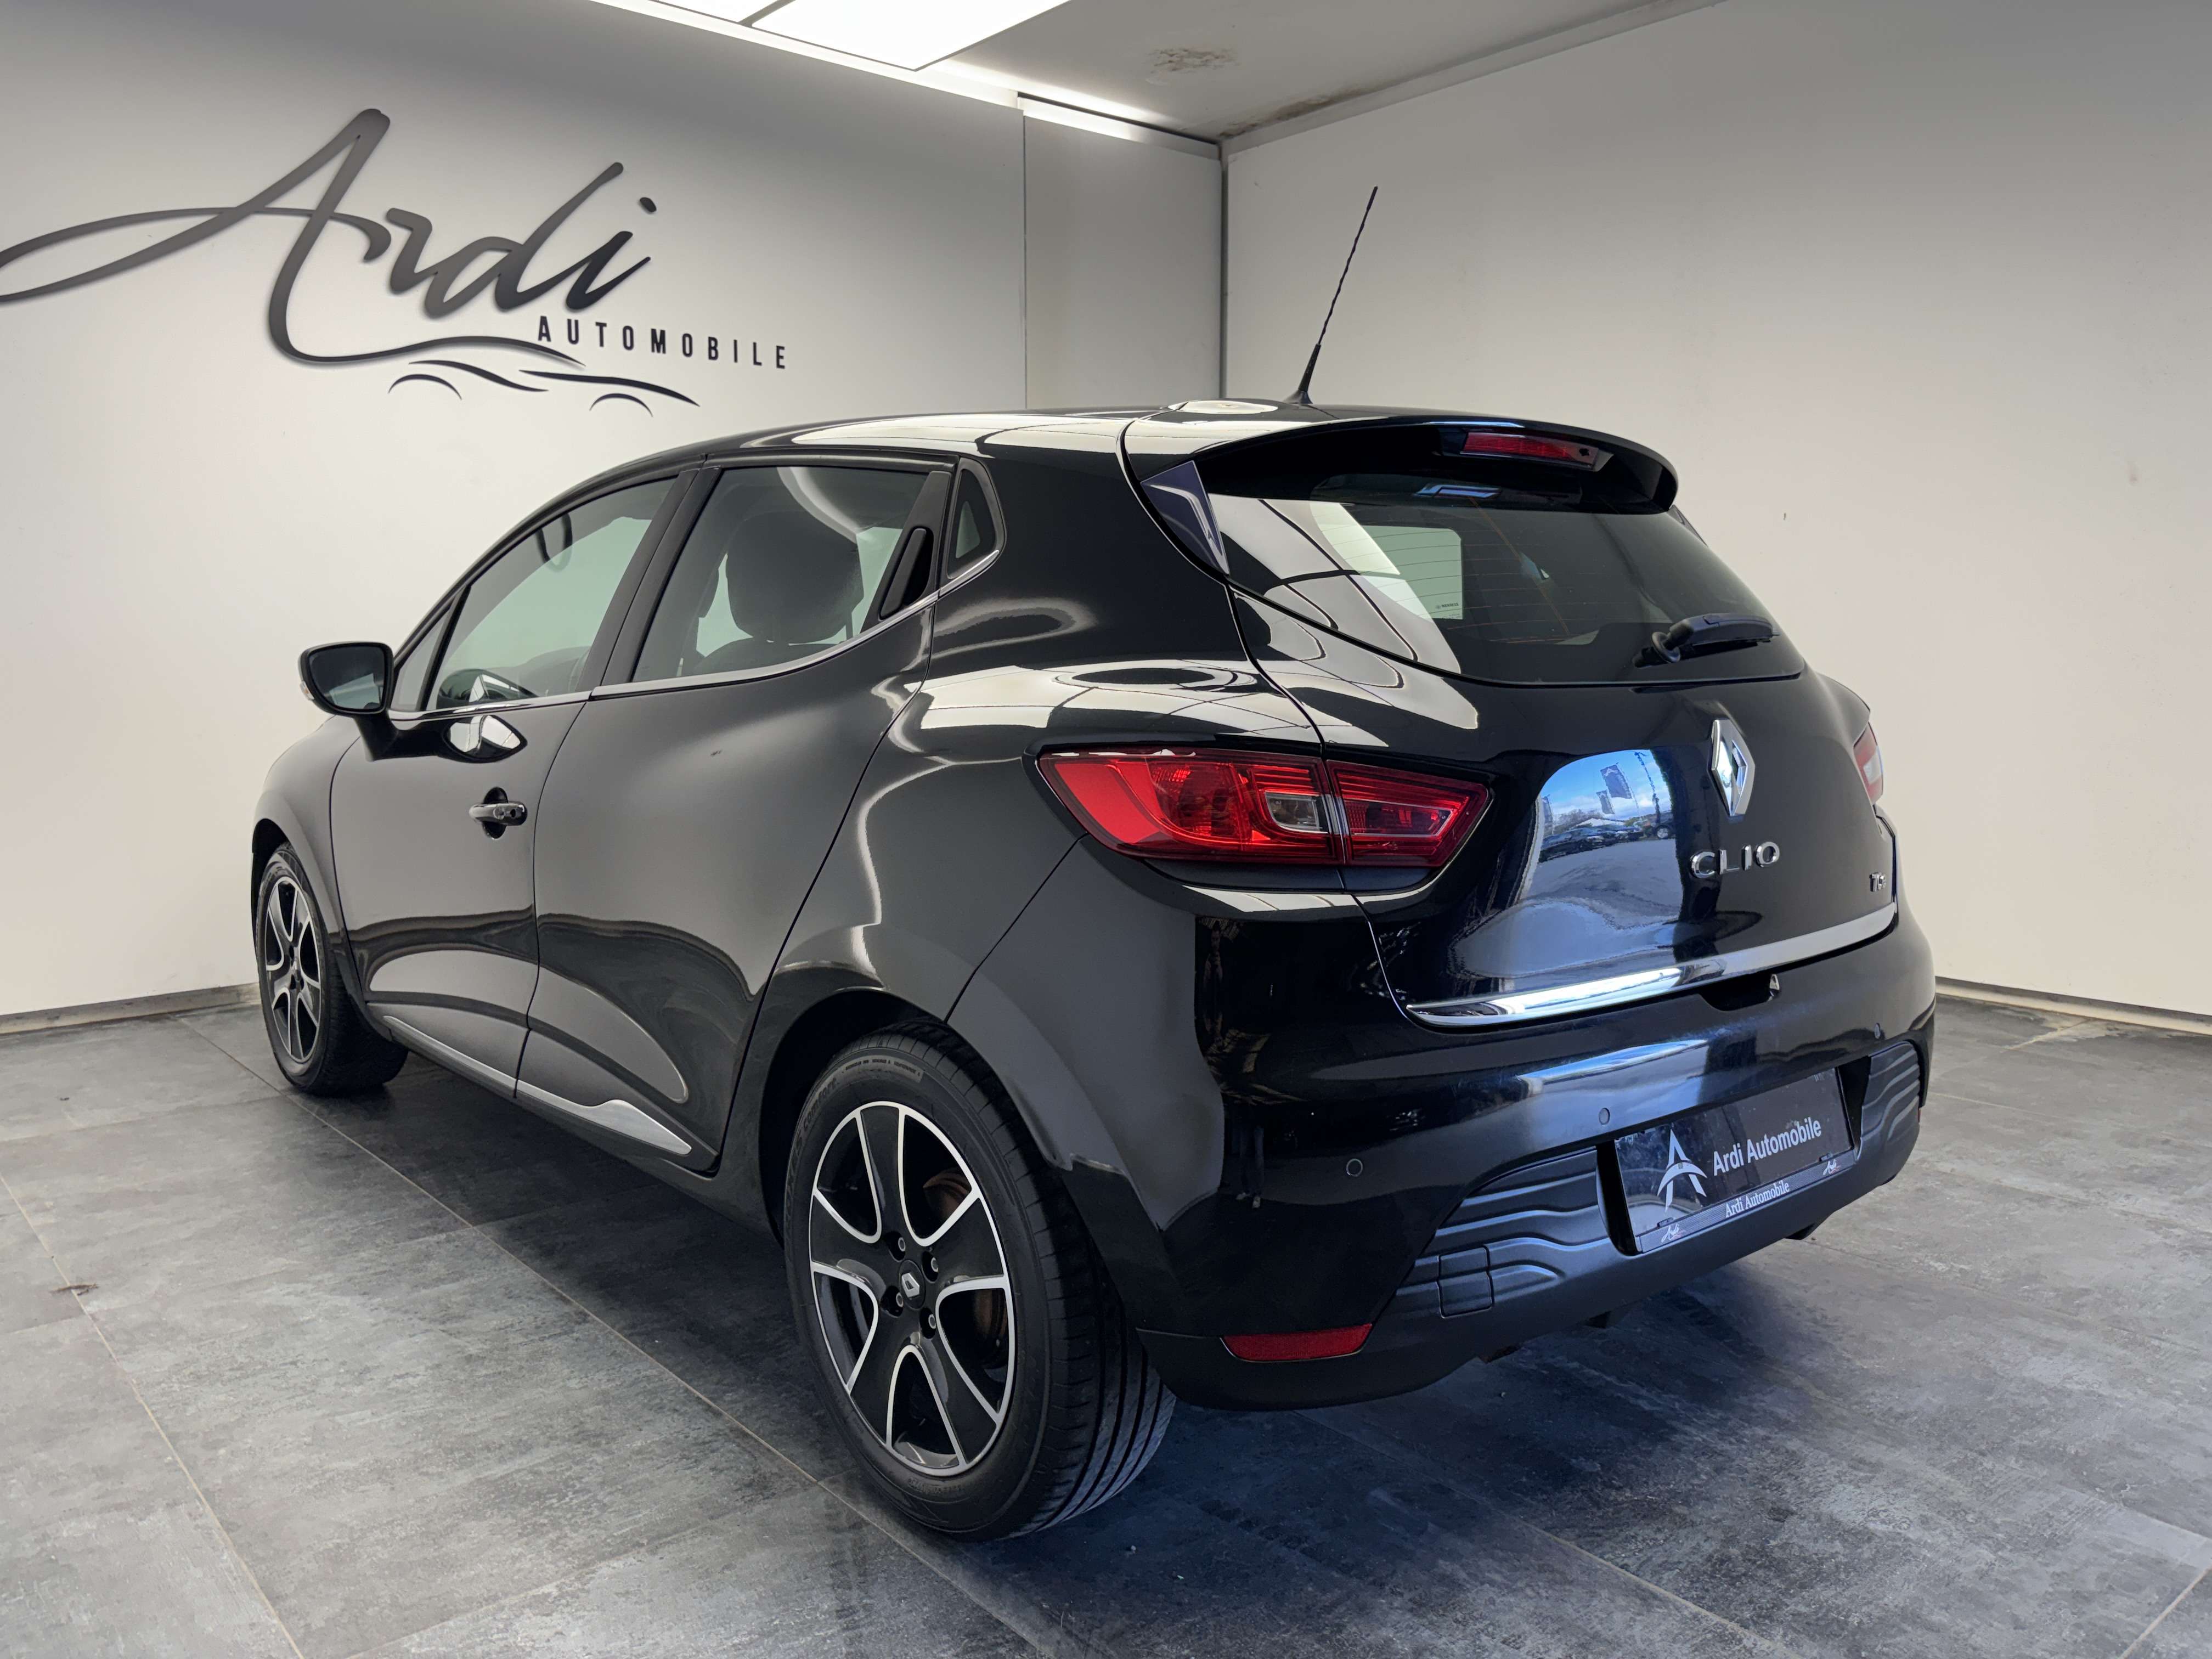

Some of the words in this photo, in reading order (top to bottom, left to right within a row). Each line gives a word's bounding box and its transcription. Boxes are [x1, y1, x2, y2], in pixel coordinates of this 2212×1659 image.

[0, 108, 657, 367] Ardi
[537, 315, 786, 369] AUTOMOBILE
[1689, 841, 1780, 878] CLIO
[1713, 1142, 1744, 1176] Ardi
[1747, 1116, 1822, 1164] Automobile
[1725, 1196, 1743, 1218] Ardi
[1745, 1179, 1790, 1209] Automobile
